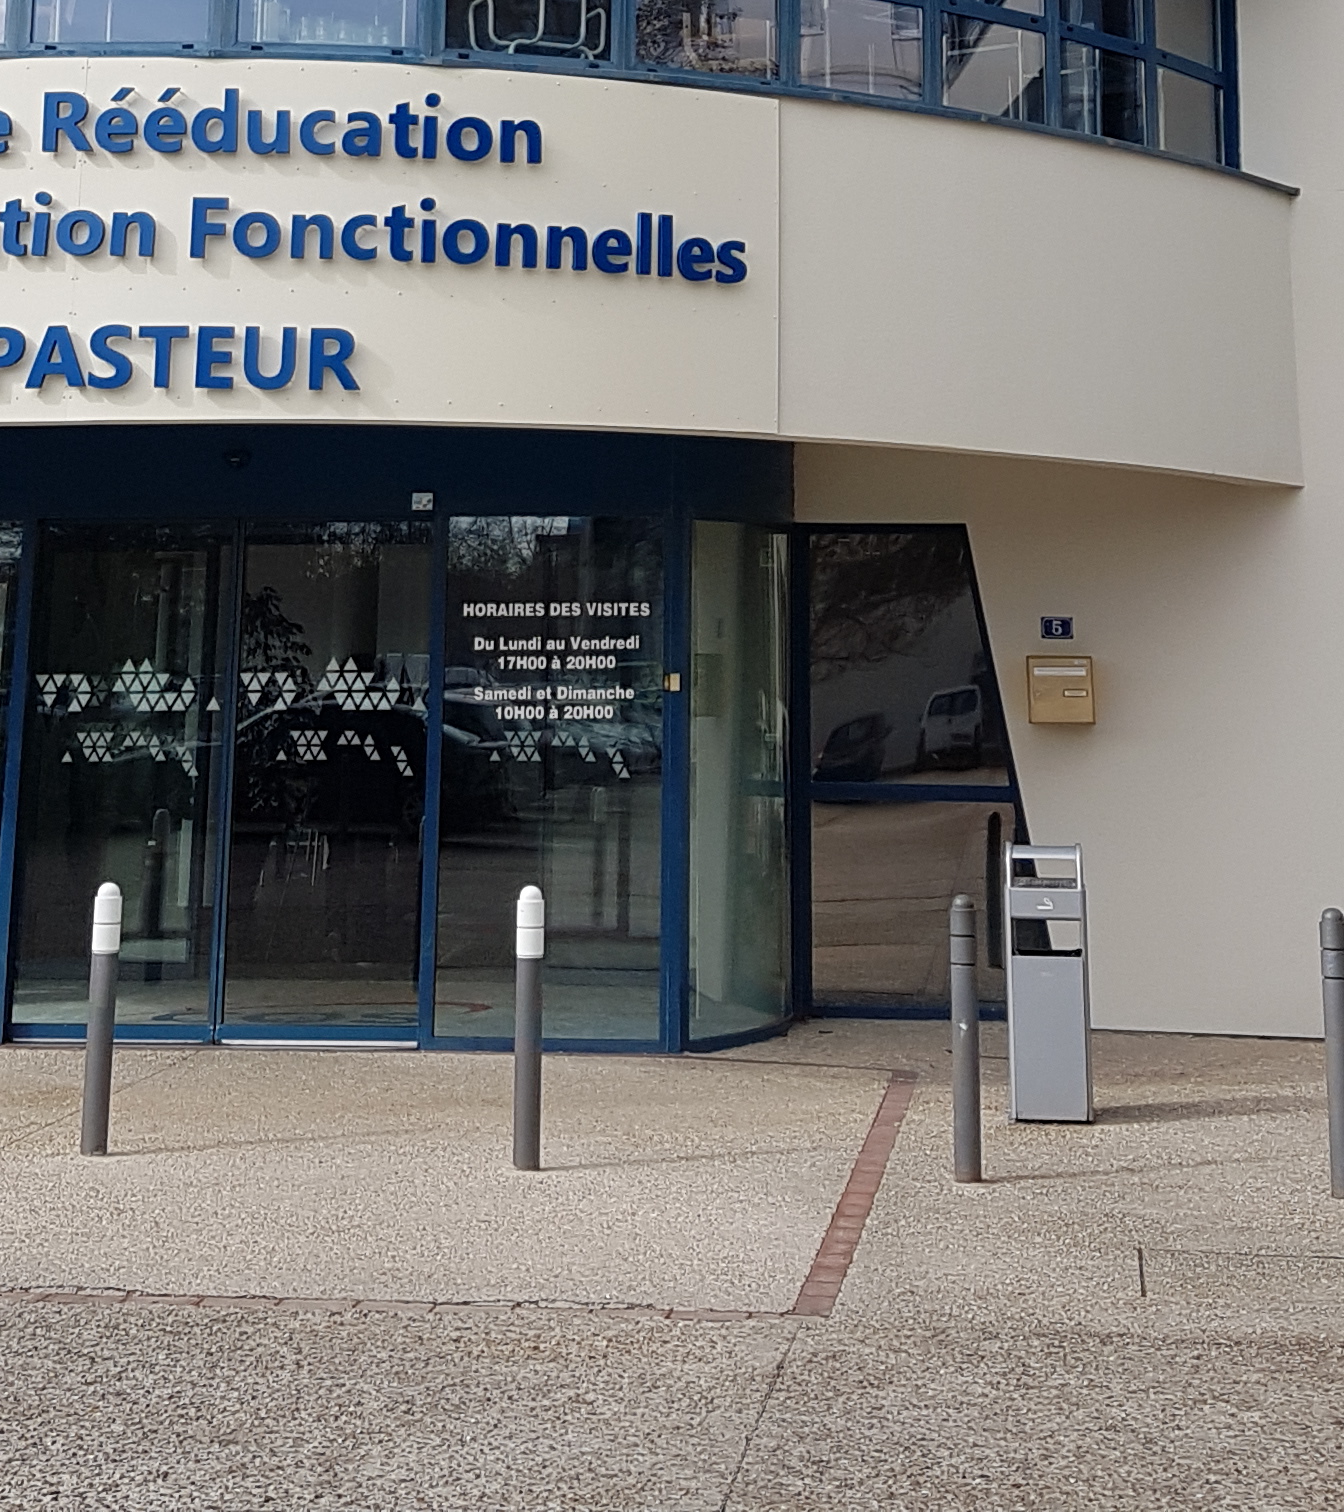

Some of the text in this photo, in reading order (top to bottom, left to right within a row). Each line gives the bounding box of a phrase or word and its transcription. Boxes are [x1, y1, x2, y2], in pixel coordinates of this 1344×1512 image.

[42, 88, 542, 164] Rééducation
[190, 196, 747, 284] Fonctionnelles
[463, 602, 650, 617] HORAIRES DES VISITES
[1052, 620, 1062, 635] 5
[474, 635, 640, 651] Du Lundi au Vendredi
[497, 655, 616, 670] 17H00 à 20H00
[473, 685, 635, 701] Samedi et Dimanche
[495, 704, 614, 720] 10H00 à 20H00
